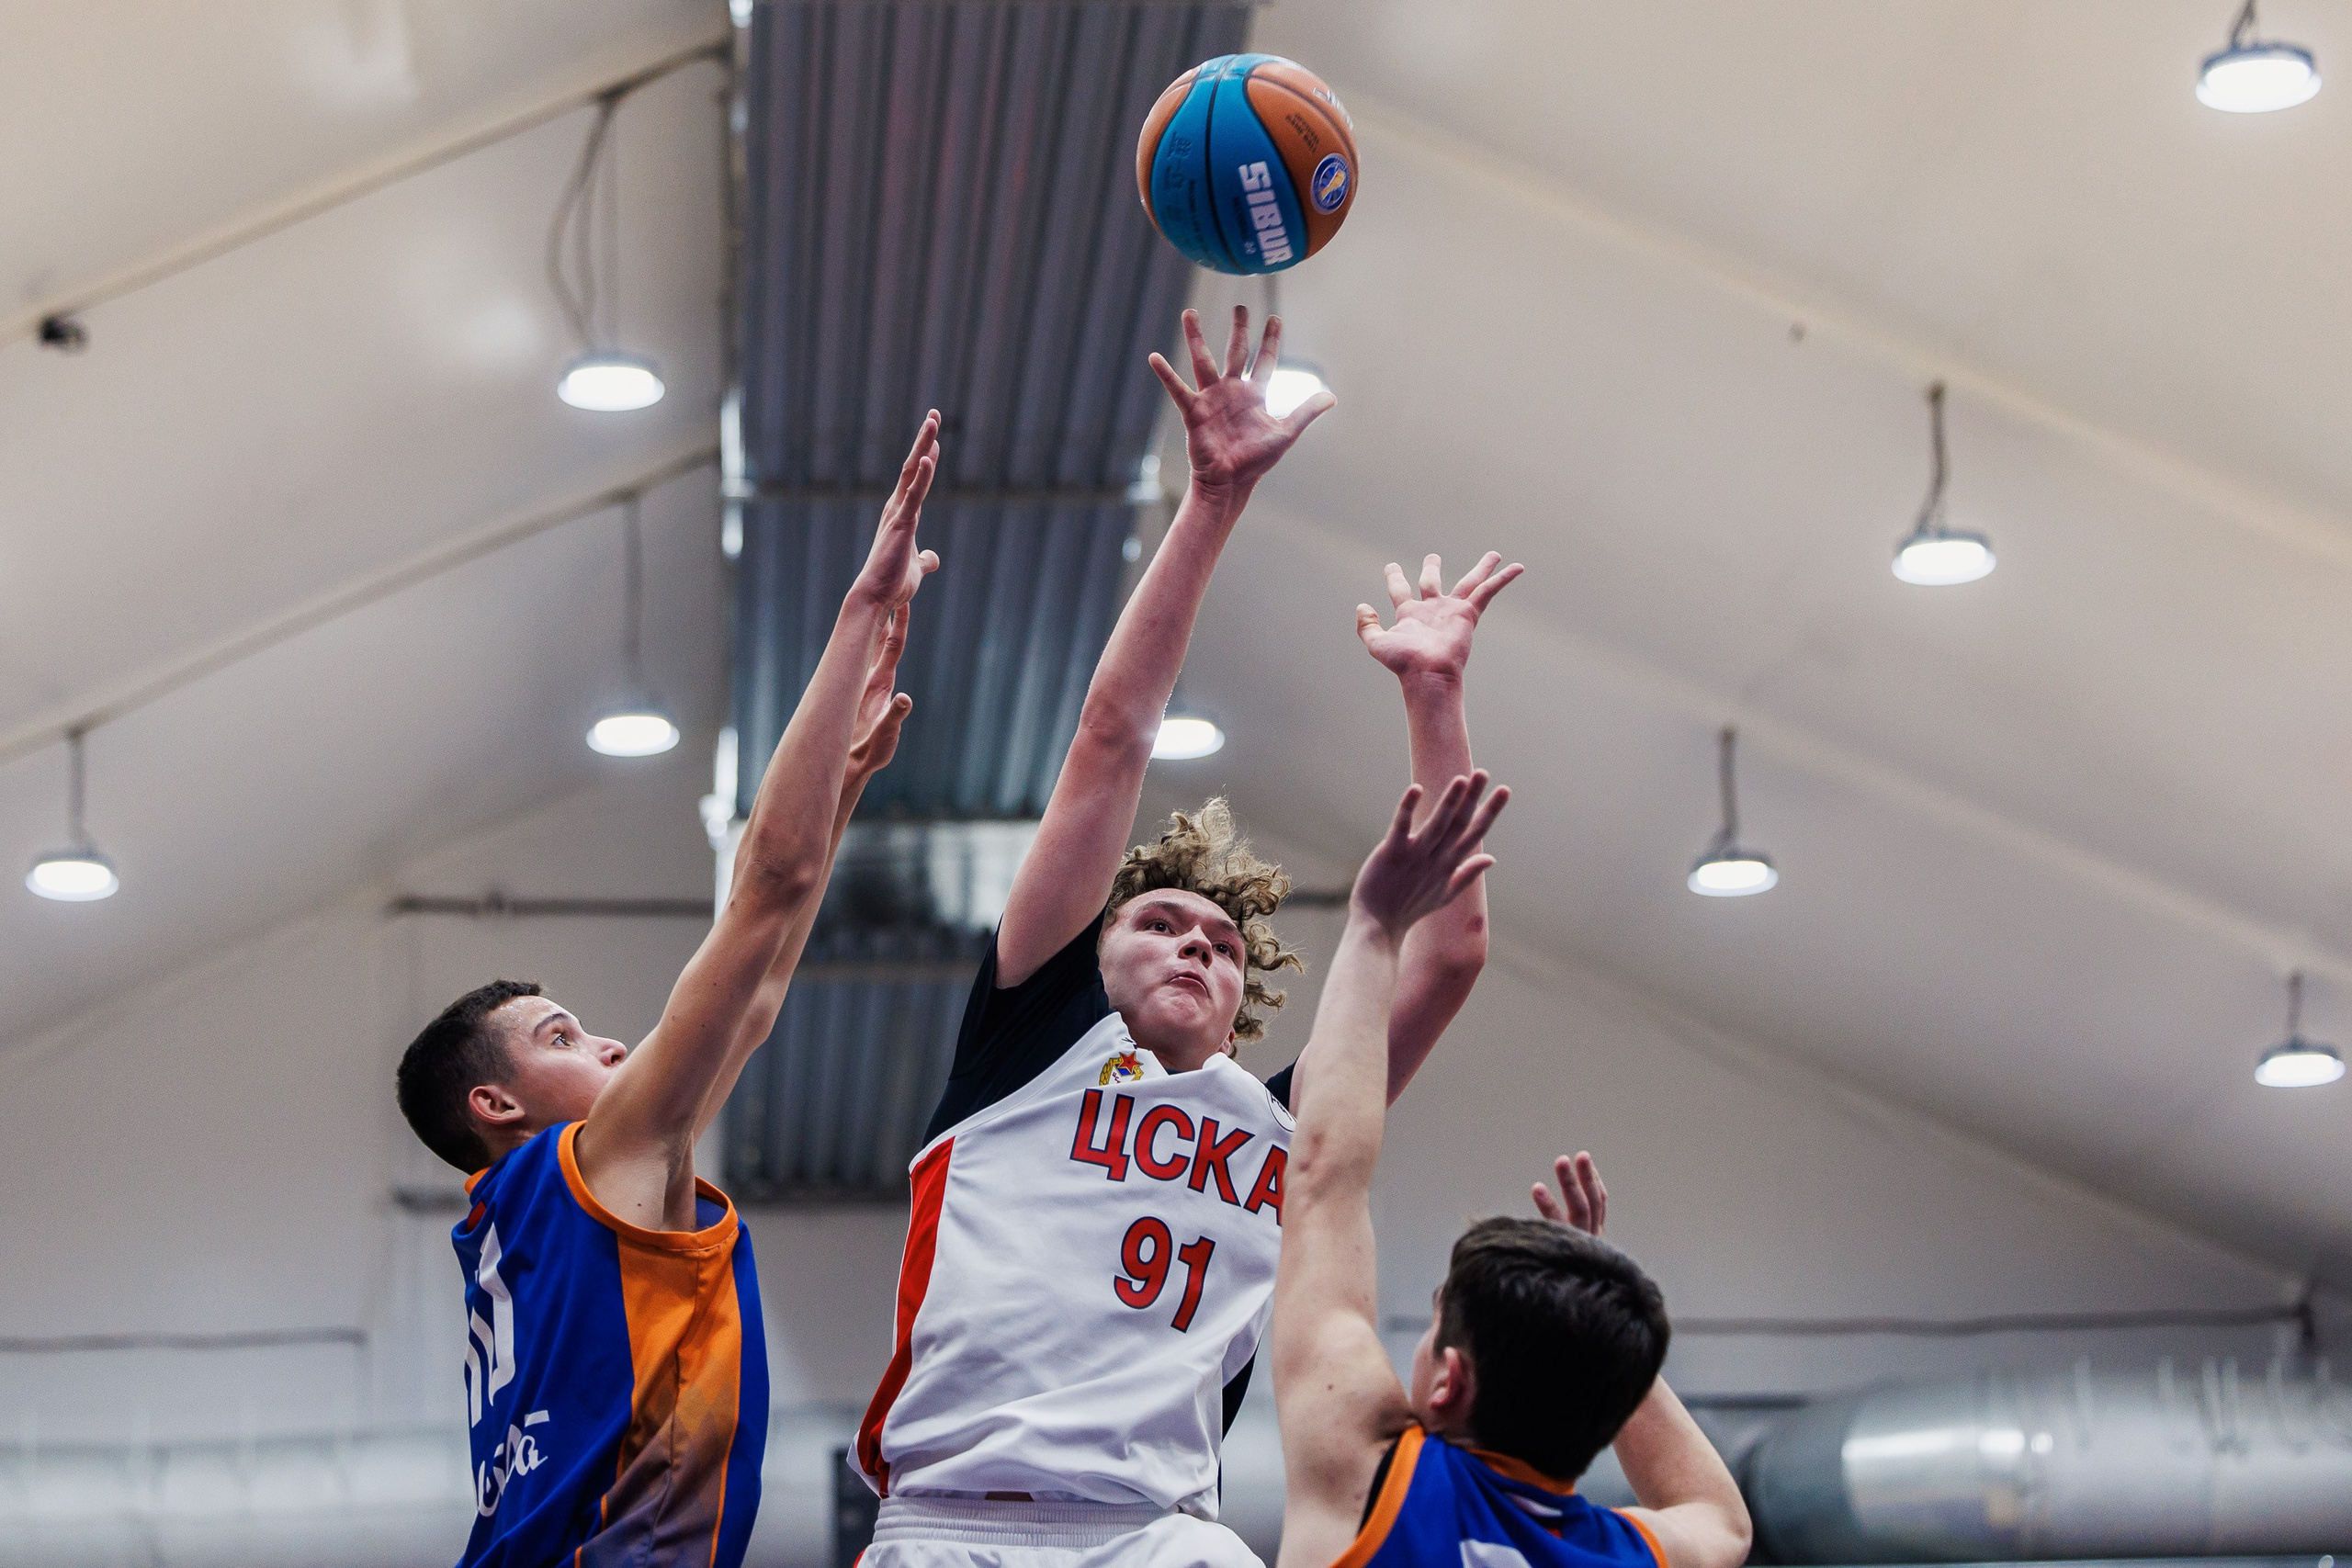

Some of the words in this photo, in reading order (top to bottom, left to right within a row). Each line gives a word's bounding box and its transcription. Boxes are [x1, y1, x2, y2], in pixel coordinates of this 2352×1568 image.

[1238, 161, 1294, 265] SIBUR
[1069, 1088, 1288, 1226] ЦСКА
[1114, 1215, 1216, 1334] 91
